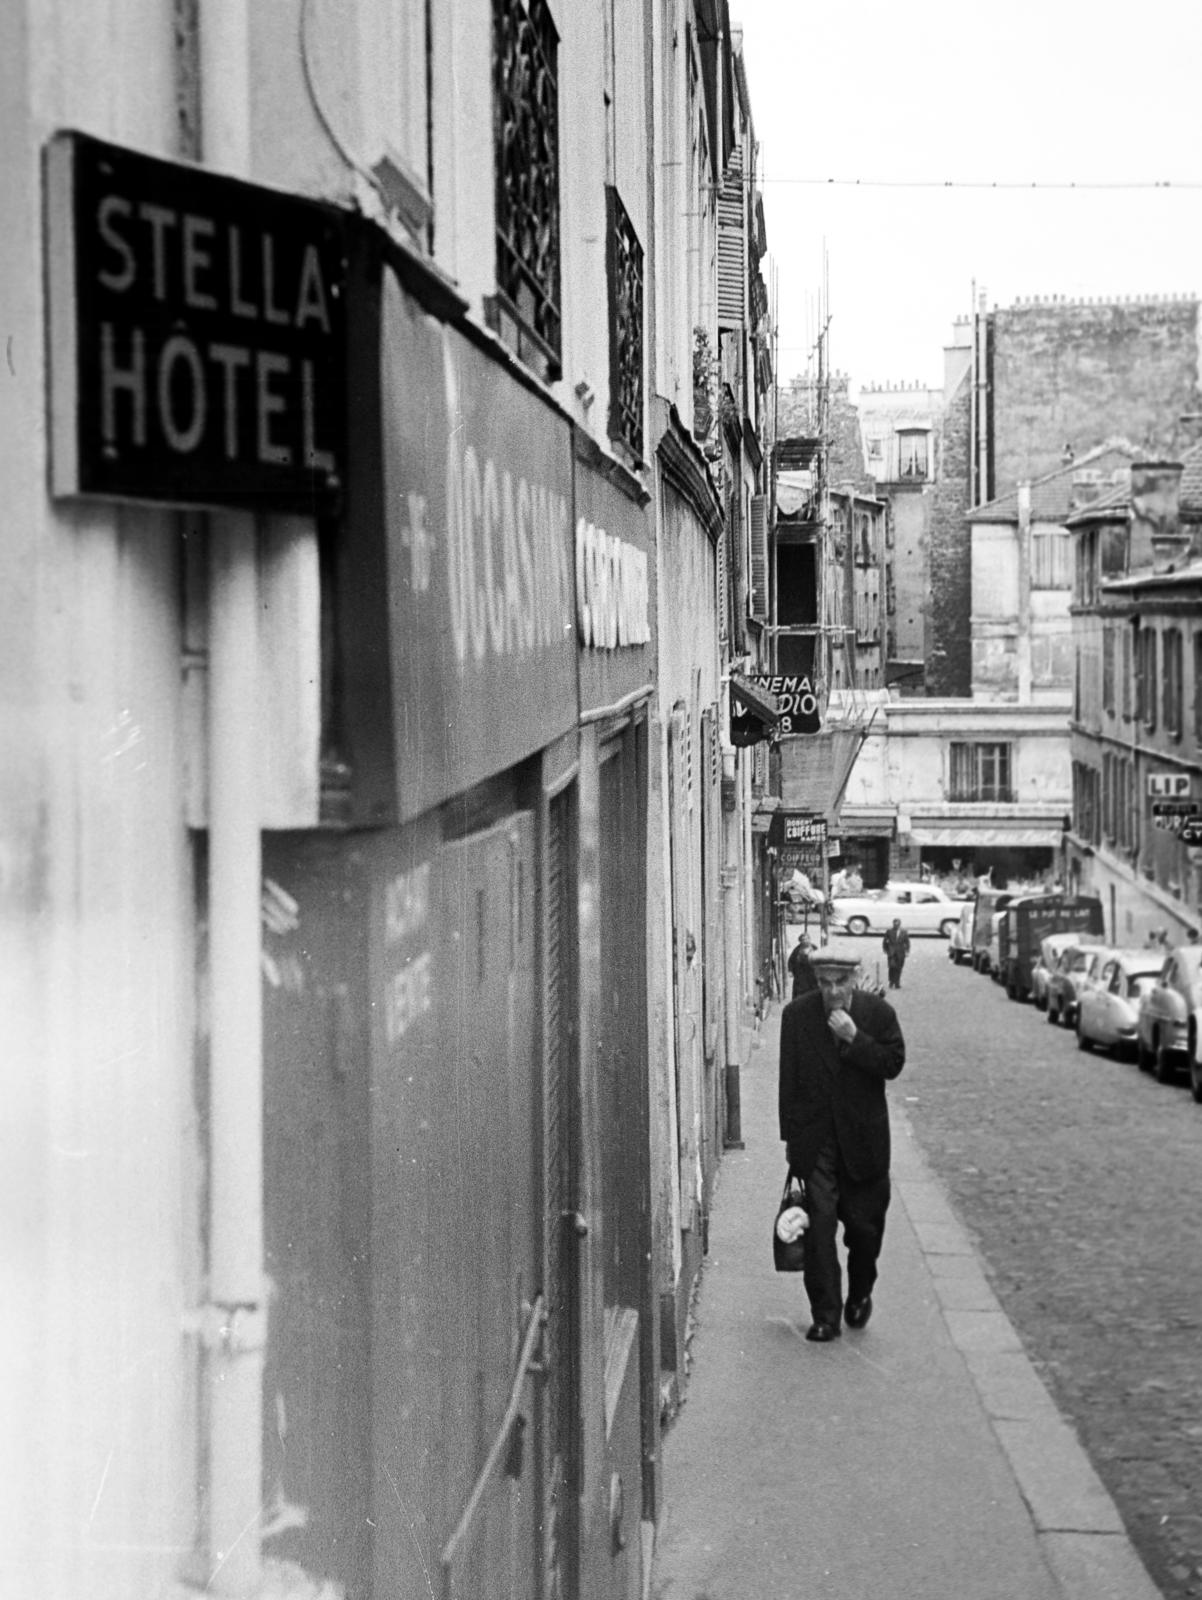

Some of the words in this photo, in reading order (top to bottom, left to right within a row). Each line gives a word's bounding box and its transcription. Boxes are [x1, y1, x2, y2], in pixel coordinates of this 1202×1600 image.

[97, 195, 331, 334] STELLA
[99, 320, 335, 472] HÔTEL
[1150, 777, 1189, 795] LIP
[786, 823, 826, 839] COIFFURE
